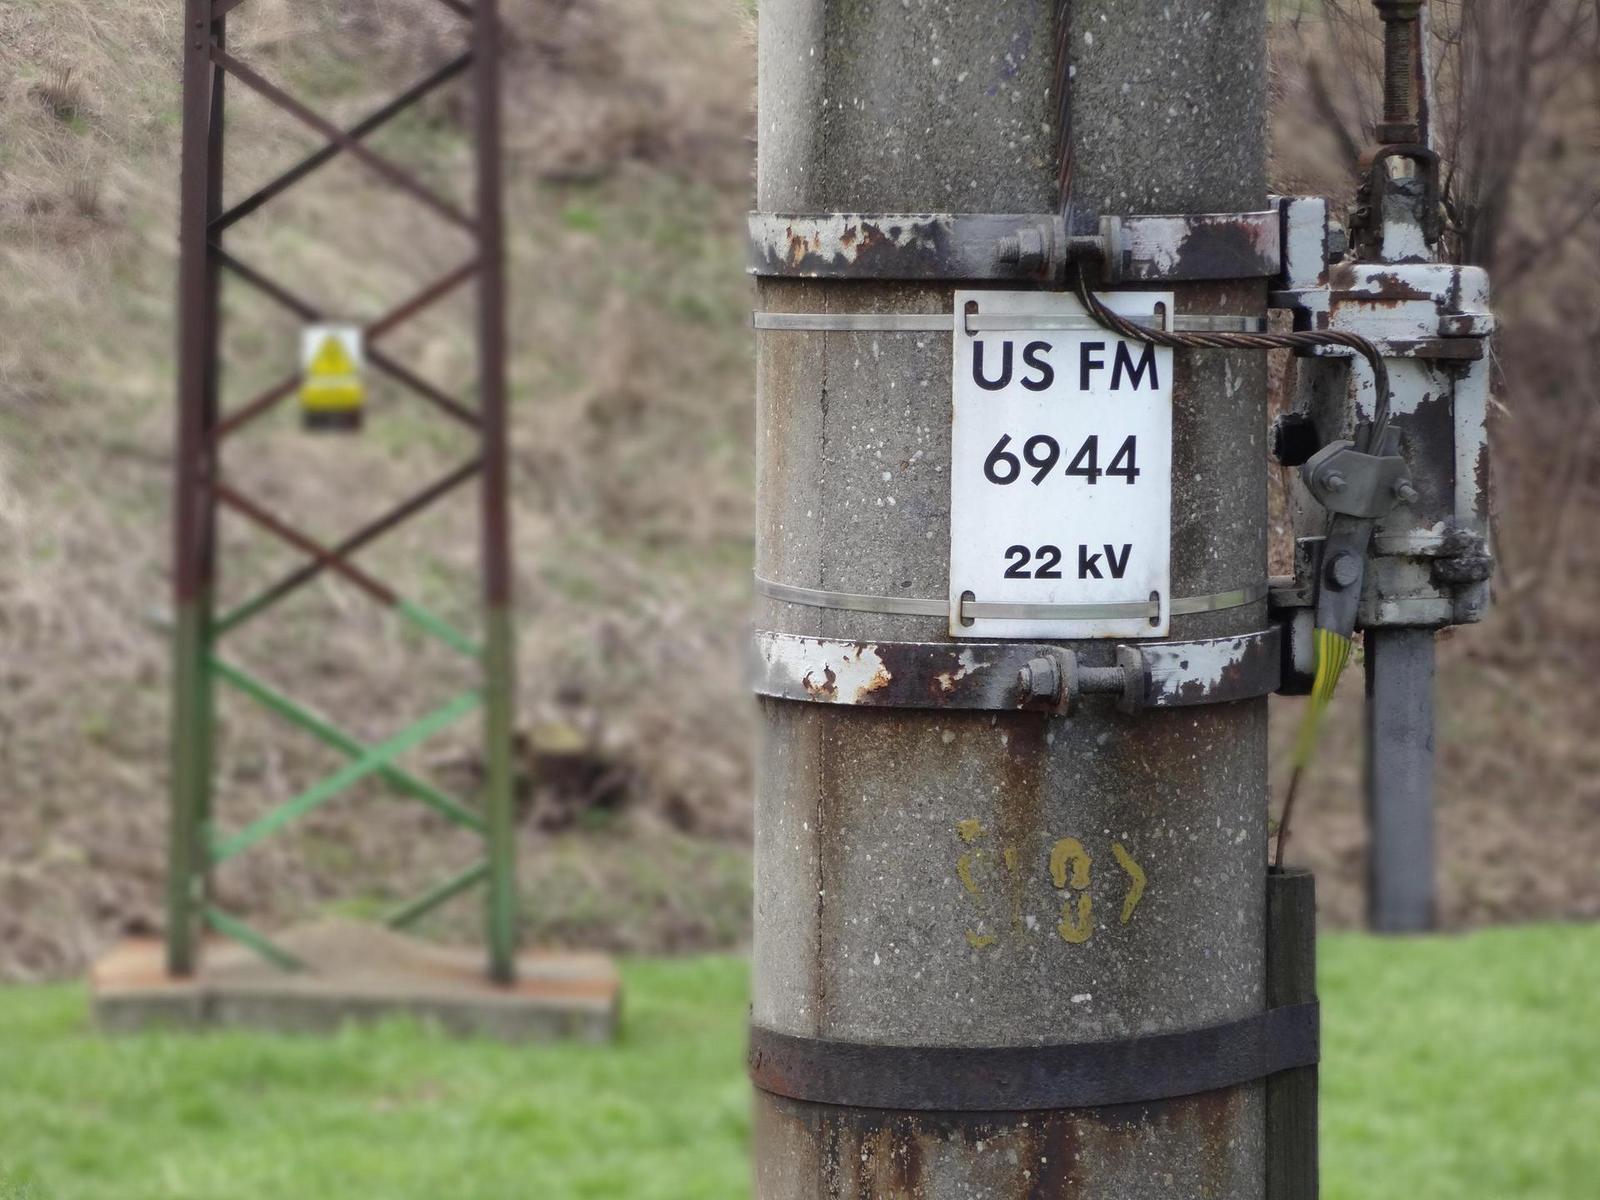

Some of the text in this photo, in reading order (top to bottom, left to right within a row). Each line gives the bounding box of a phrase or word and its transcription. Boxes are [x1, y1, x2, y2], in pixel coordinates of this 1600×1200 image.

[972, 340, 1160, 392] US FM
[983, 433, 1140, 486] 6944
[1003, 543, 1133, 579] 22 kV
